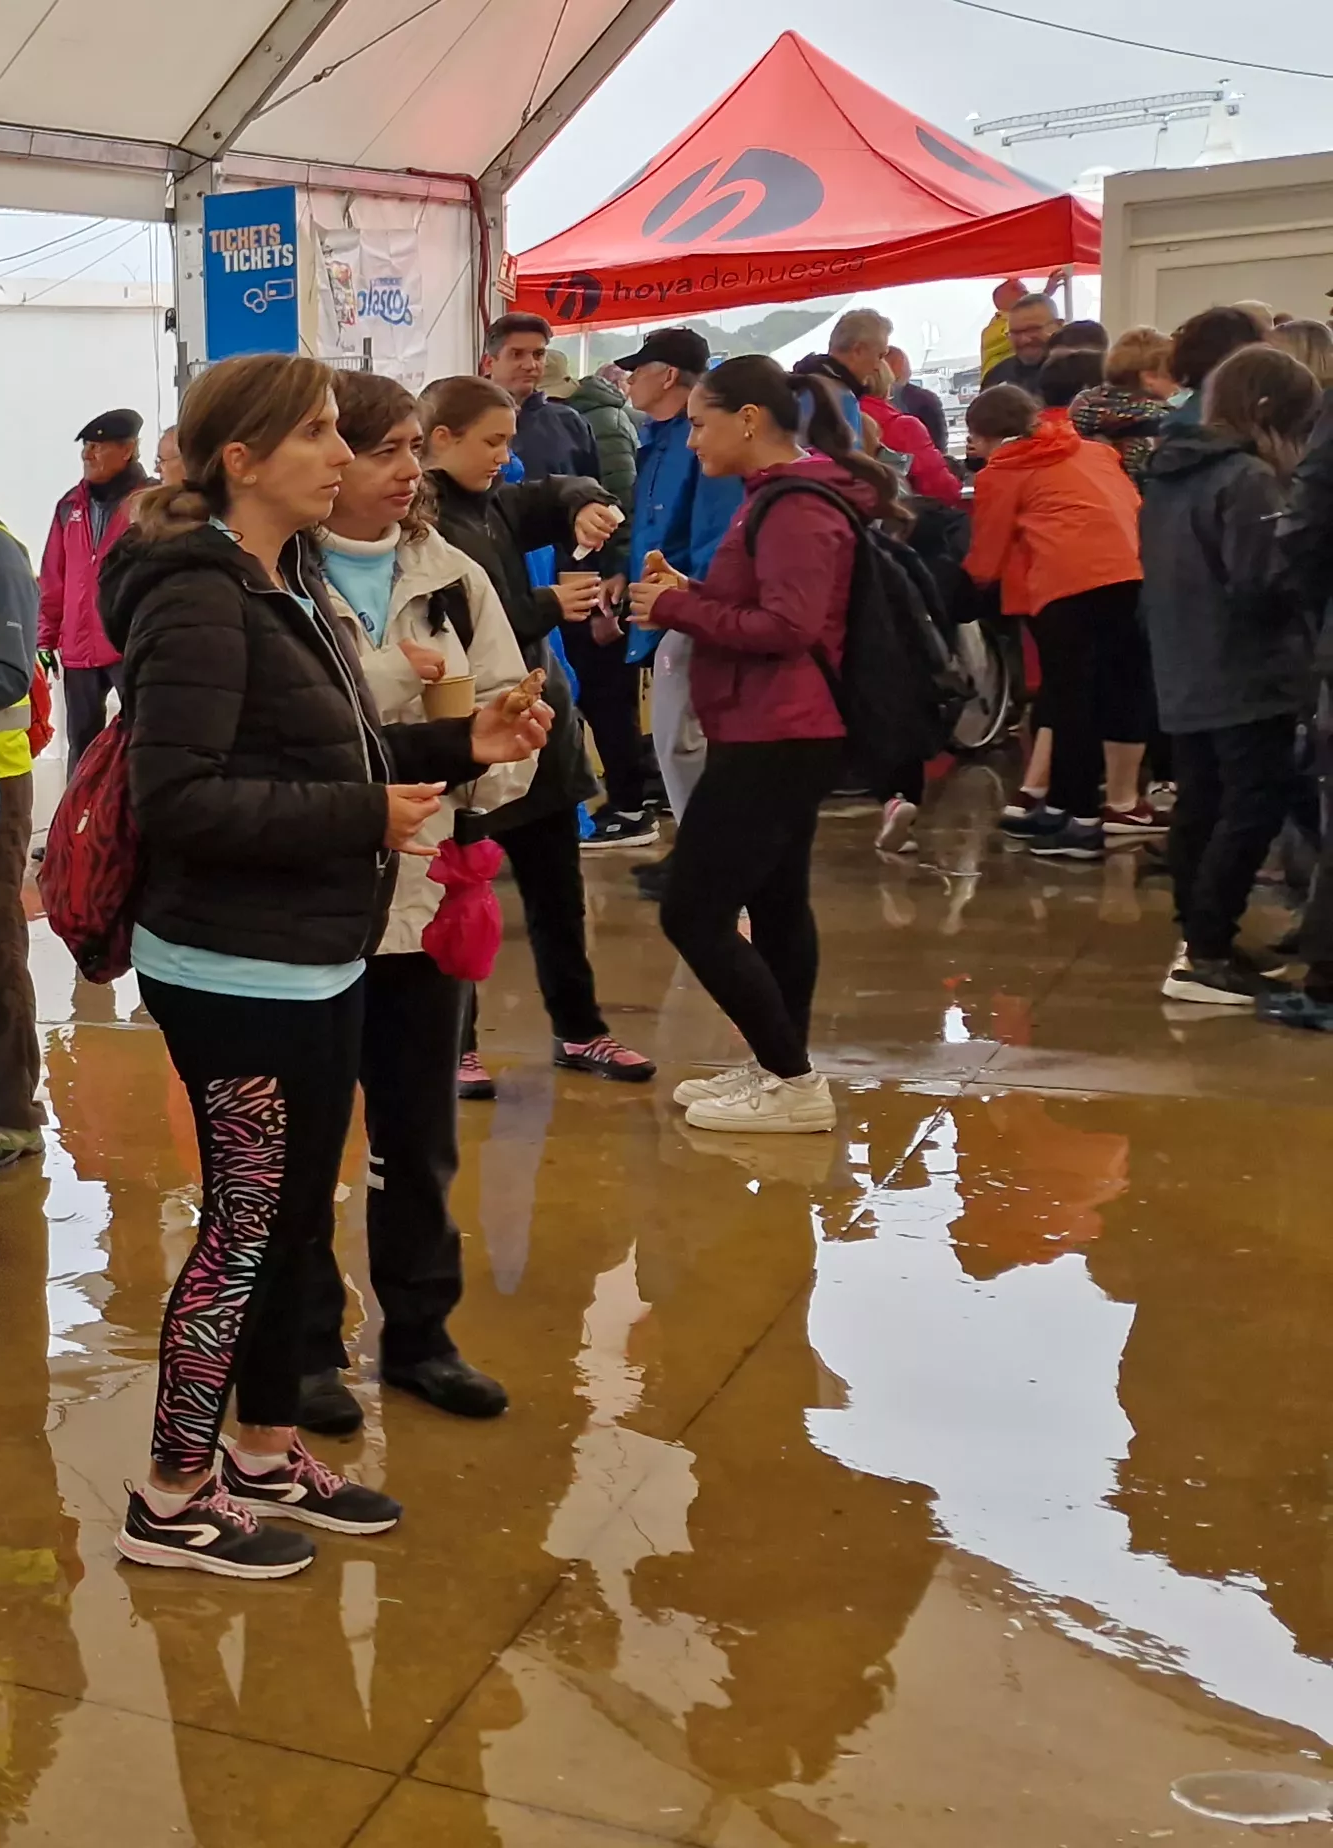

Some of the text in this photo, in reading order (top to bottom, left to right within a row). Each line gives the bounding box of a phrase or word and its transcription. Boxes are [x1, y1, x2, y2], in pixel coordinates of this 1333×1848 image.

[209, 223, 281, 253] TICKETS
[222, 243, 294, 273] TICKETS
[613, 275, 693, 303] hoya
[700, 266, 739, 290] de
